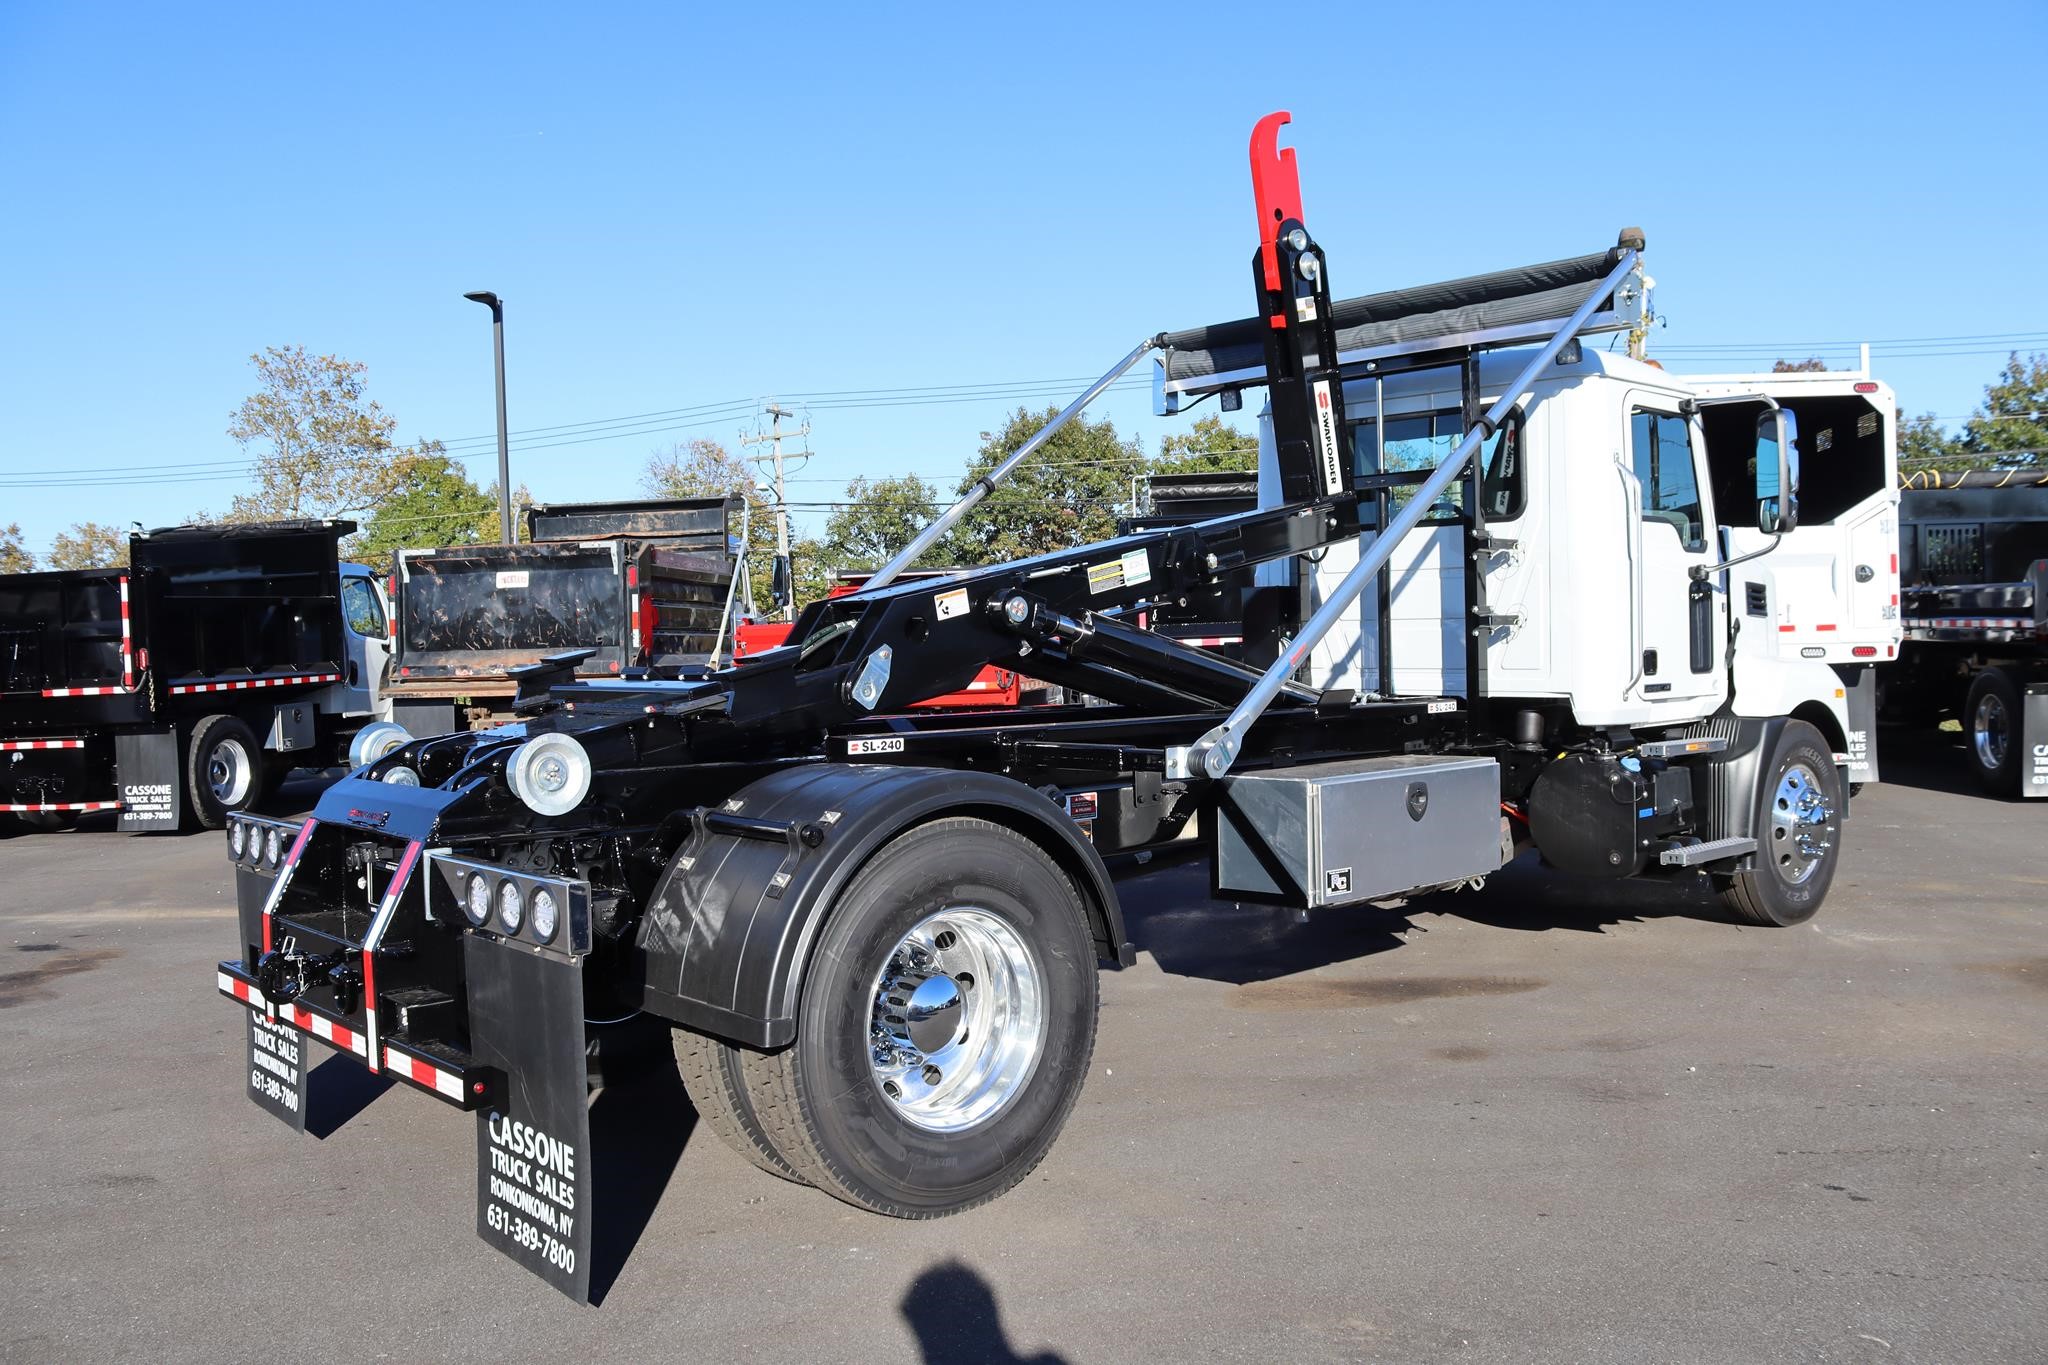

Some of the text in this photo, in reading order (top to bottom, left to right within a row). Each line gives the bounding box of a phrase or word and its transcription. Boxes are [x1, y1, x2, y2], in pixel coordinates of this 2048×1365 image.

[1322, 411, 1337, 485] SWAPLOADER
[862, 740, 902, 752] SL-240
[125, 785, 172, 796] CASSONE
[125, 796, 149, 804] TRUCK
[253, 1026, 298, 1065] TRUCK SALES
[252, 1069, 299, 1112] 631-389-7800
[291, 1067, 298, 1085] NY
[489, 1111, 575, 1181] CASSONE
[490, 1146, 575, 1210] TRUCK SALES
[490, 1175, 574, 1238] RONKONKOMA, NY
[487, 1203, 575, 1274] 631-389-7800
